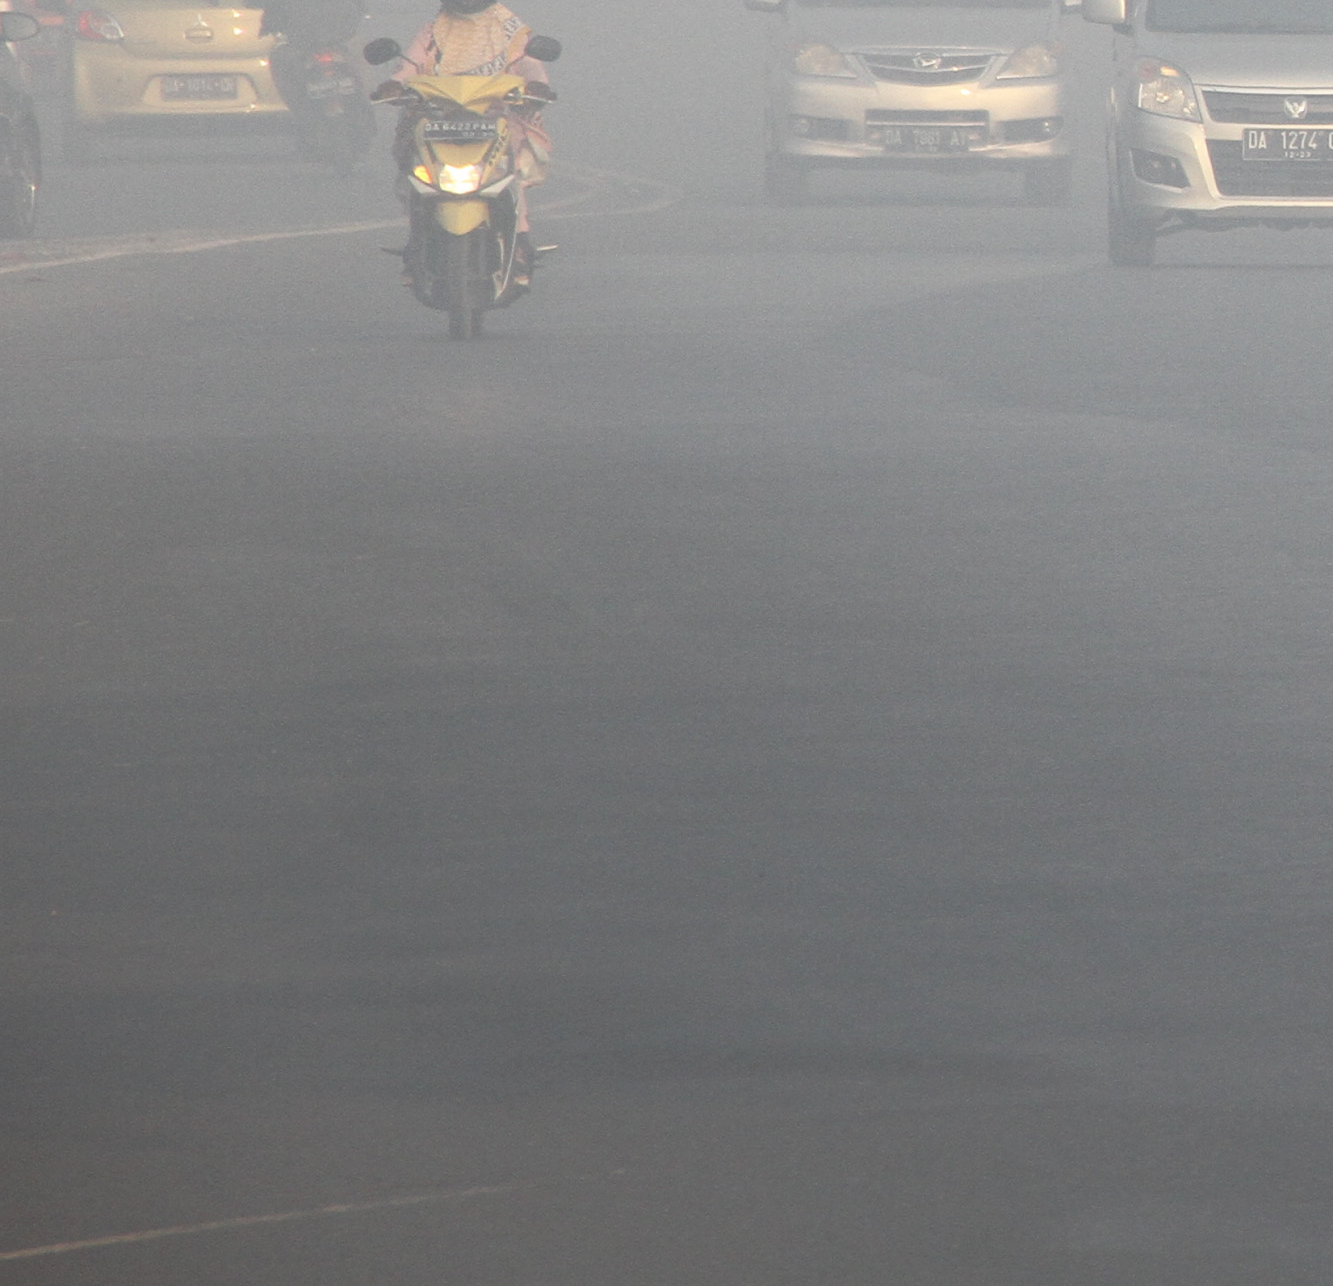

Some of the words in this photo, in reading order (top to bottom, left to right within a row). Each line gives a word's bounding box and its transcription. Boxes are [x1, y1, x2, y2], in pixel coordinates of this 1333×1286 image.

[425, 122, 440, 131] DA
[1248, 130, 1267, 149] DA
[1281, 131, 1317, 150] 1274
